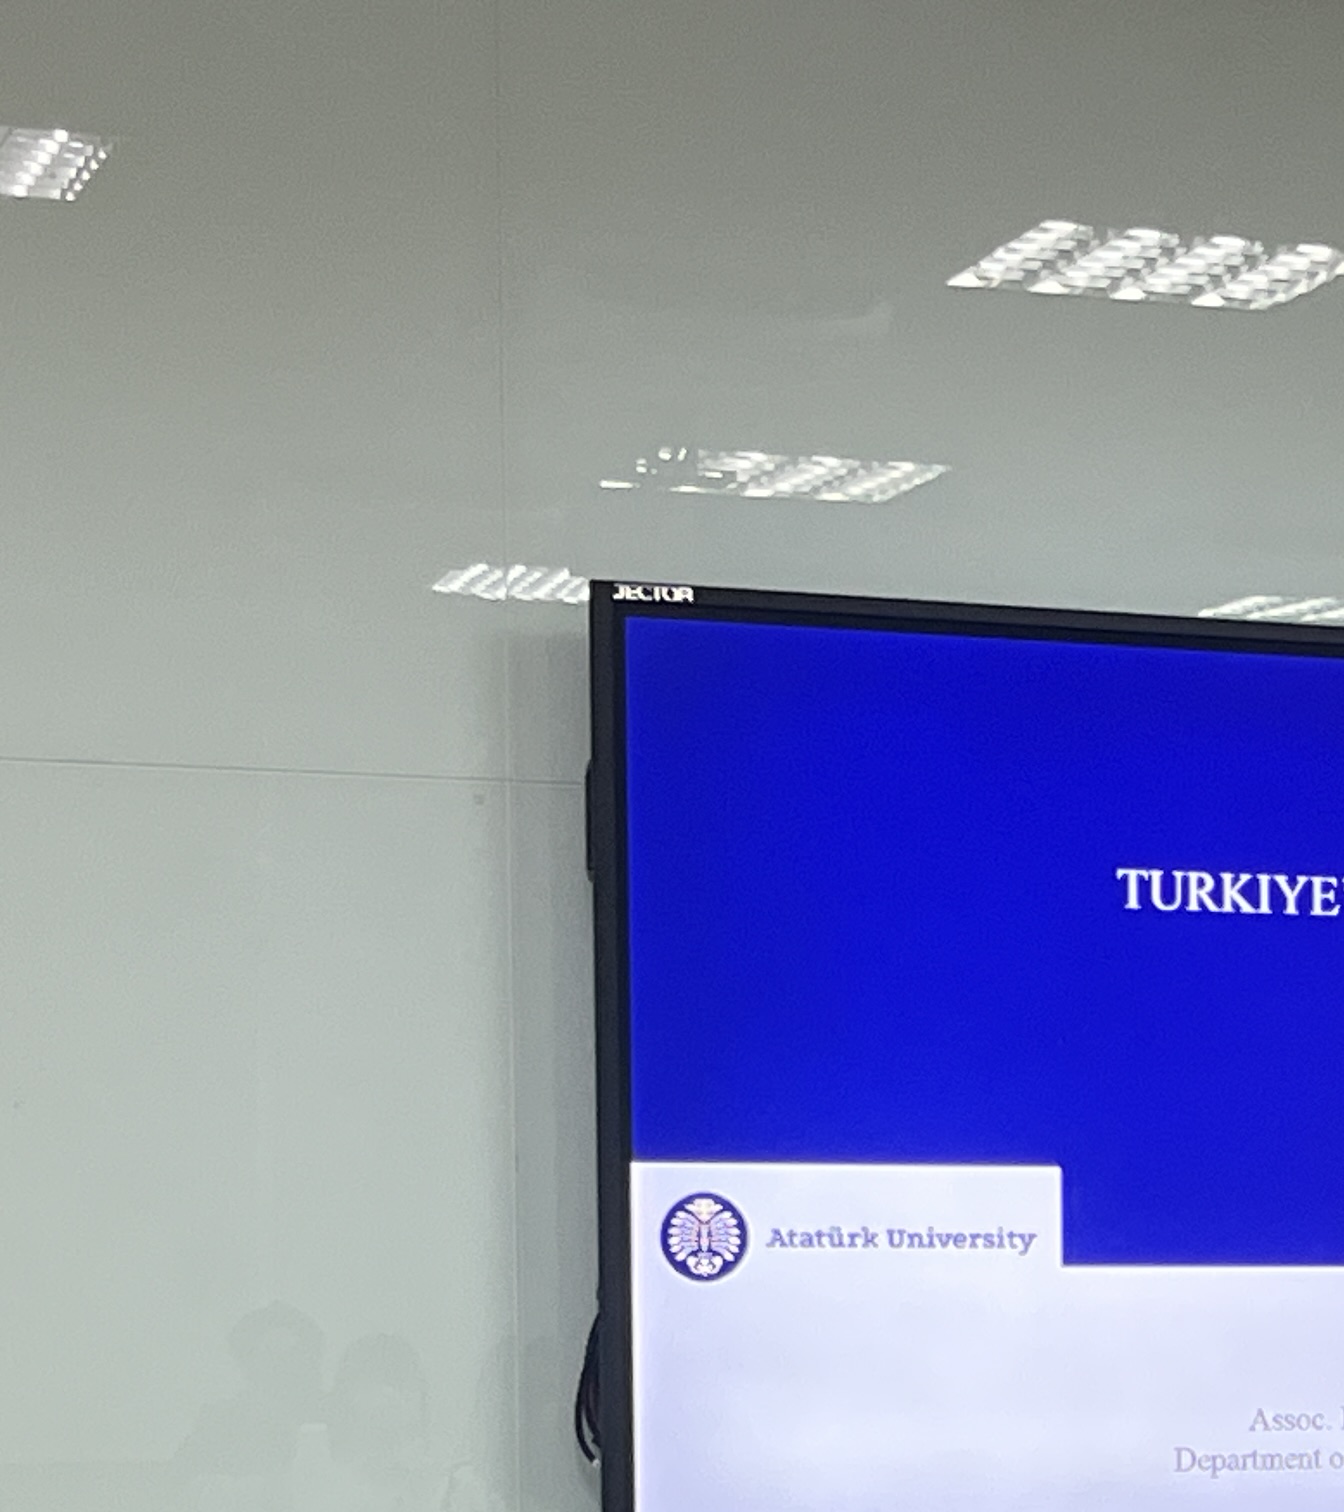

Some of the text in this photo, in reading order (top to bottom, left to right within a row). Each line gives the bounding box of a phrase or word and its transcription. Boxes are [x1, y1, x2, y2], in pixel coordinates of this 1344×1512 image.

[765, 1226, 1038, 1256] Atatürk University
[1249, 1407, 1332, 1432] Assoc.
[1173, 1447, 1322, 1479] Department
